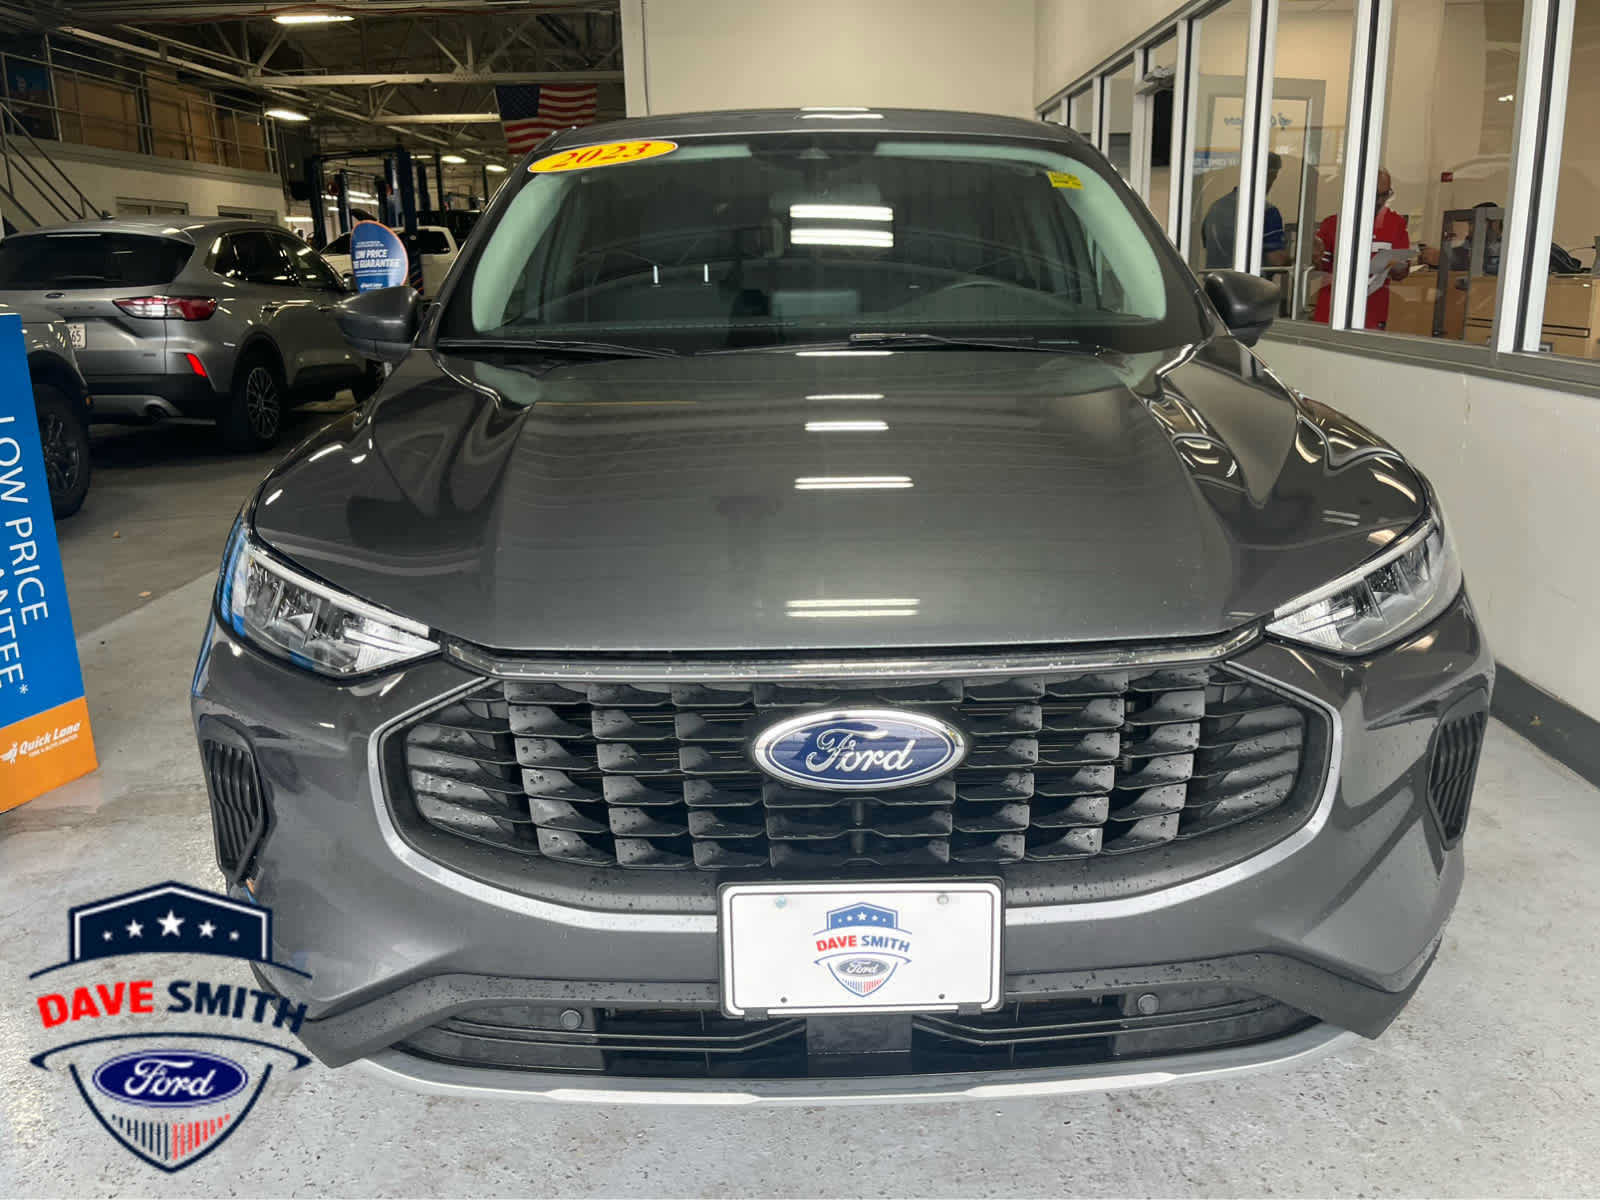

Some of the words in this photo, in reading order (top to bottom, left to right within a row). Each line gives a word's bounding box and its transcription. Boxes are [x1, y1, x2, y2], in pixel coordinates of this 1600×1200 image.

[551, 142, 652, 169] 2023
[5, 516, 49, 626] PRICE
[19, 731, 52, 755] Quick
[53, 721, 81, 741] Lane
[805, 728, 917, 773] Ford
[816, 935, 857, 952] DAVE
[861, 935, 911, 953] SMITH
[846, 960, 880, 975] Ford
